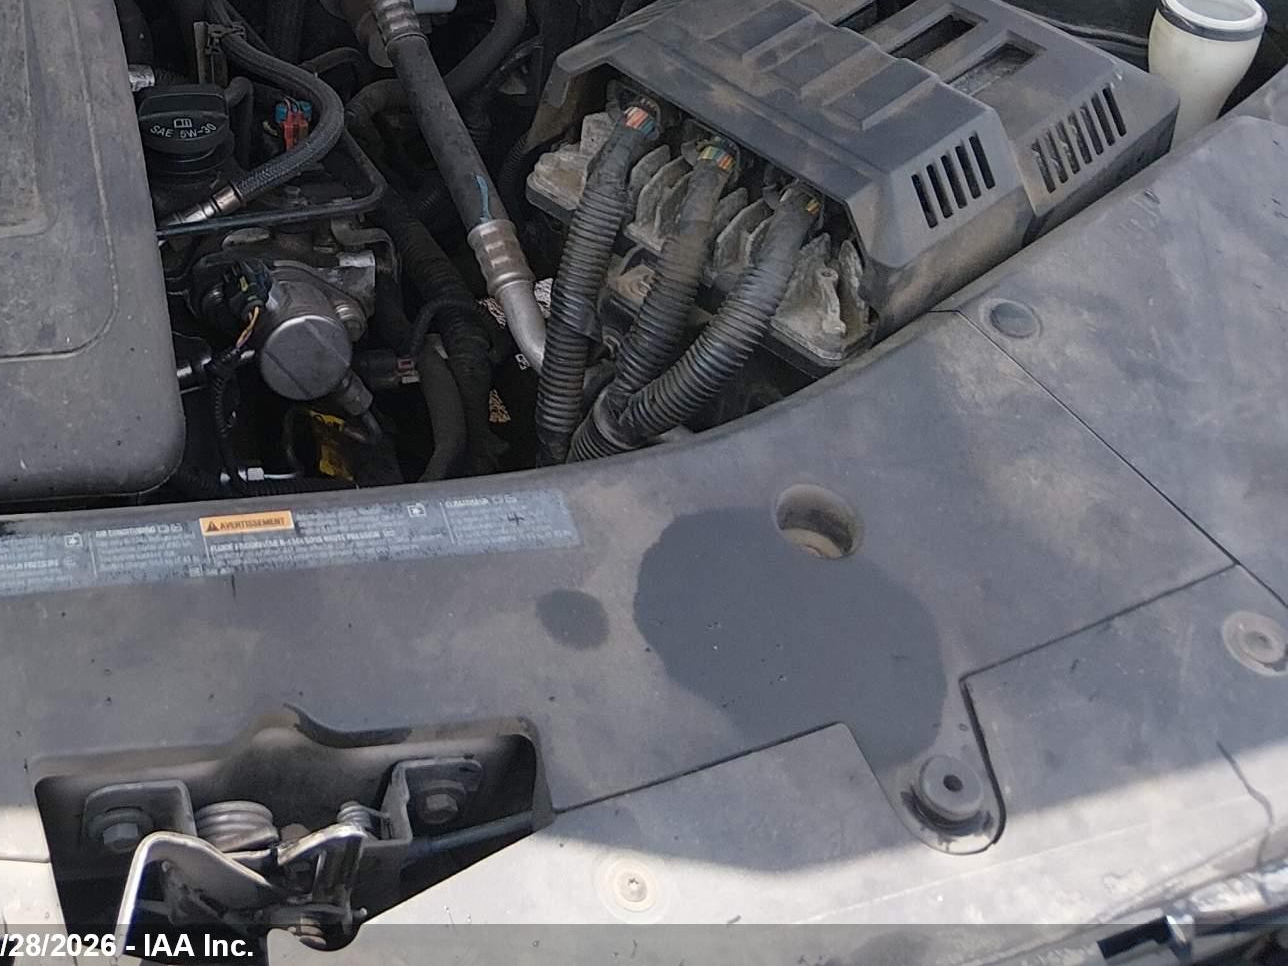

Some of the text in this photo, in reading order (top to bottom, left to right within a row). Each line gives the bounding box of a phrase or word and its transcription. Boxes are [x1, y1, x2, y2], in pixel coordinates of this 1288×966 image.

[150, 123, 217, 138] SAE 5W-30
[219, 517, 286, 532] AVERTISSEMENT
